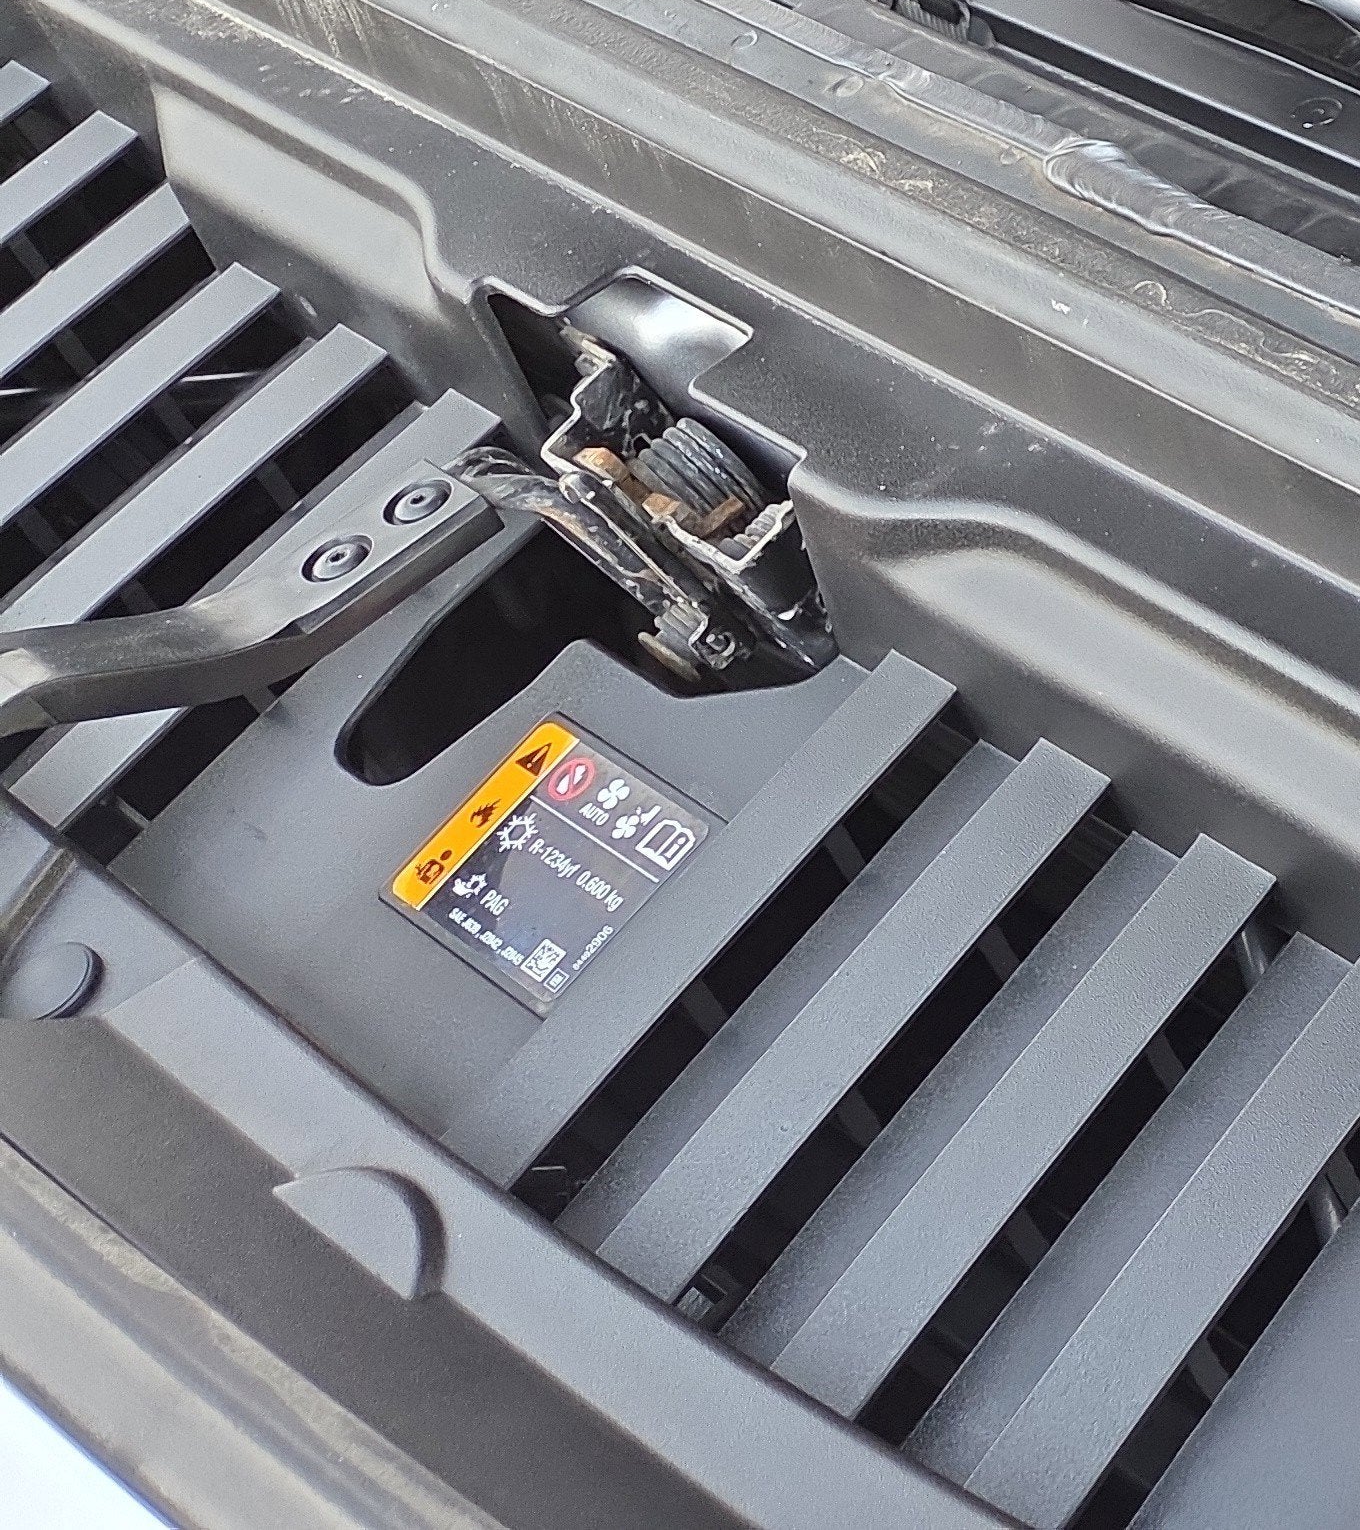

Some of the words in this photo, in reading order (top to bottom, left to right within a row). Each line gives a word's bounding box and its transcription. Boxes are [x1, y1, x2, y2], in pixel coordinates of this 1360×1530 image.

[579, 803, 609, 825] AUTO
[528, 838, 581, 878] R-1234yf
[576, 871, 611, 899] 0.600
[603, 889, 624, 912] kg
[480, 890, 510, 915] PAG
